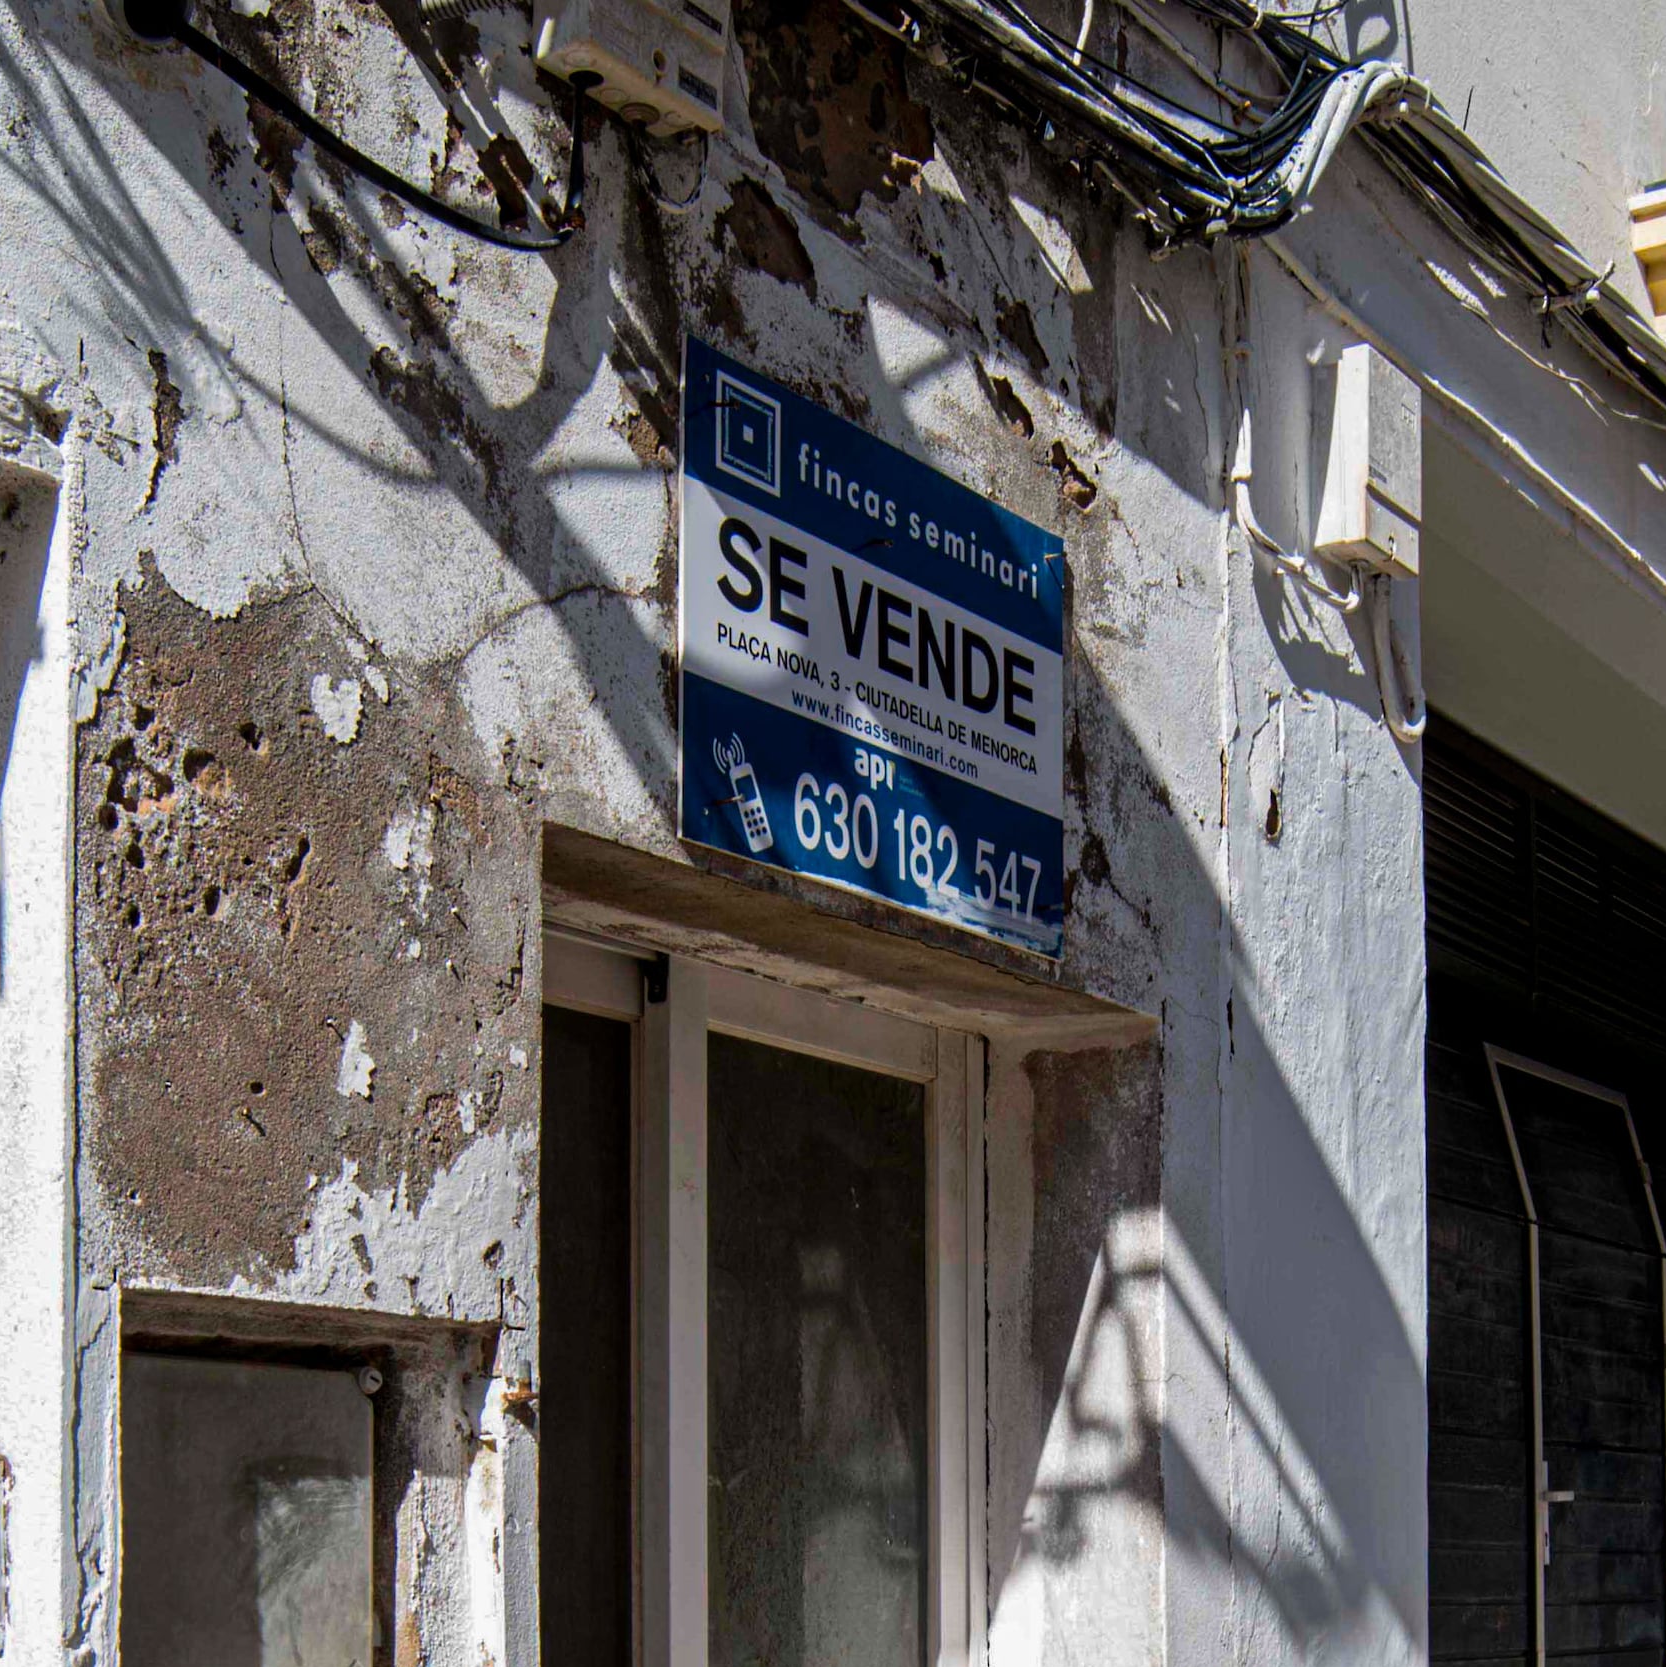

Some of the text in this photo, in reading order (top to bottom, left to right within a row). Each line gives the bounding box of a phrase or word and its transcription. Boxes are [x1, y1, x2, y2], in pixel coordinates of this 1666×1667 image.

[798, 444, 1039, 600] fincas seminari
[716, 516, 1037, 736] SE VENDE
[717, 622, 772, 664] PLAÇA
[777, 647, 827, 690] NOVA,
[830, 670, 841, 692] 3
[855, 680, 944, 737] CIUTADELLA
[948, 718, 967, 744] DE
[971, 727, 1038, 776] MENORCA
[791, 688, 980, 780] www.fincasseminari.com
[853, 746, 897, 791] api
[794, 771, 1043, 922] 630 182 547
